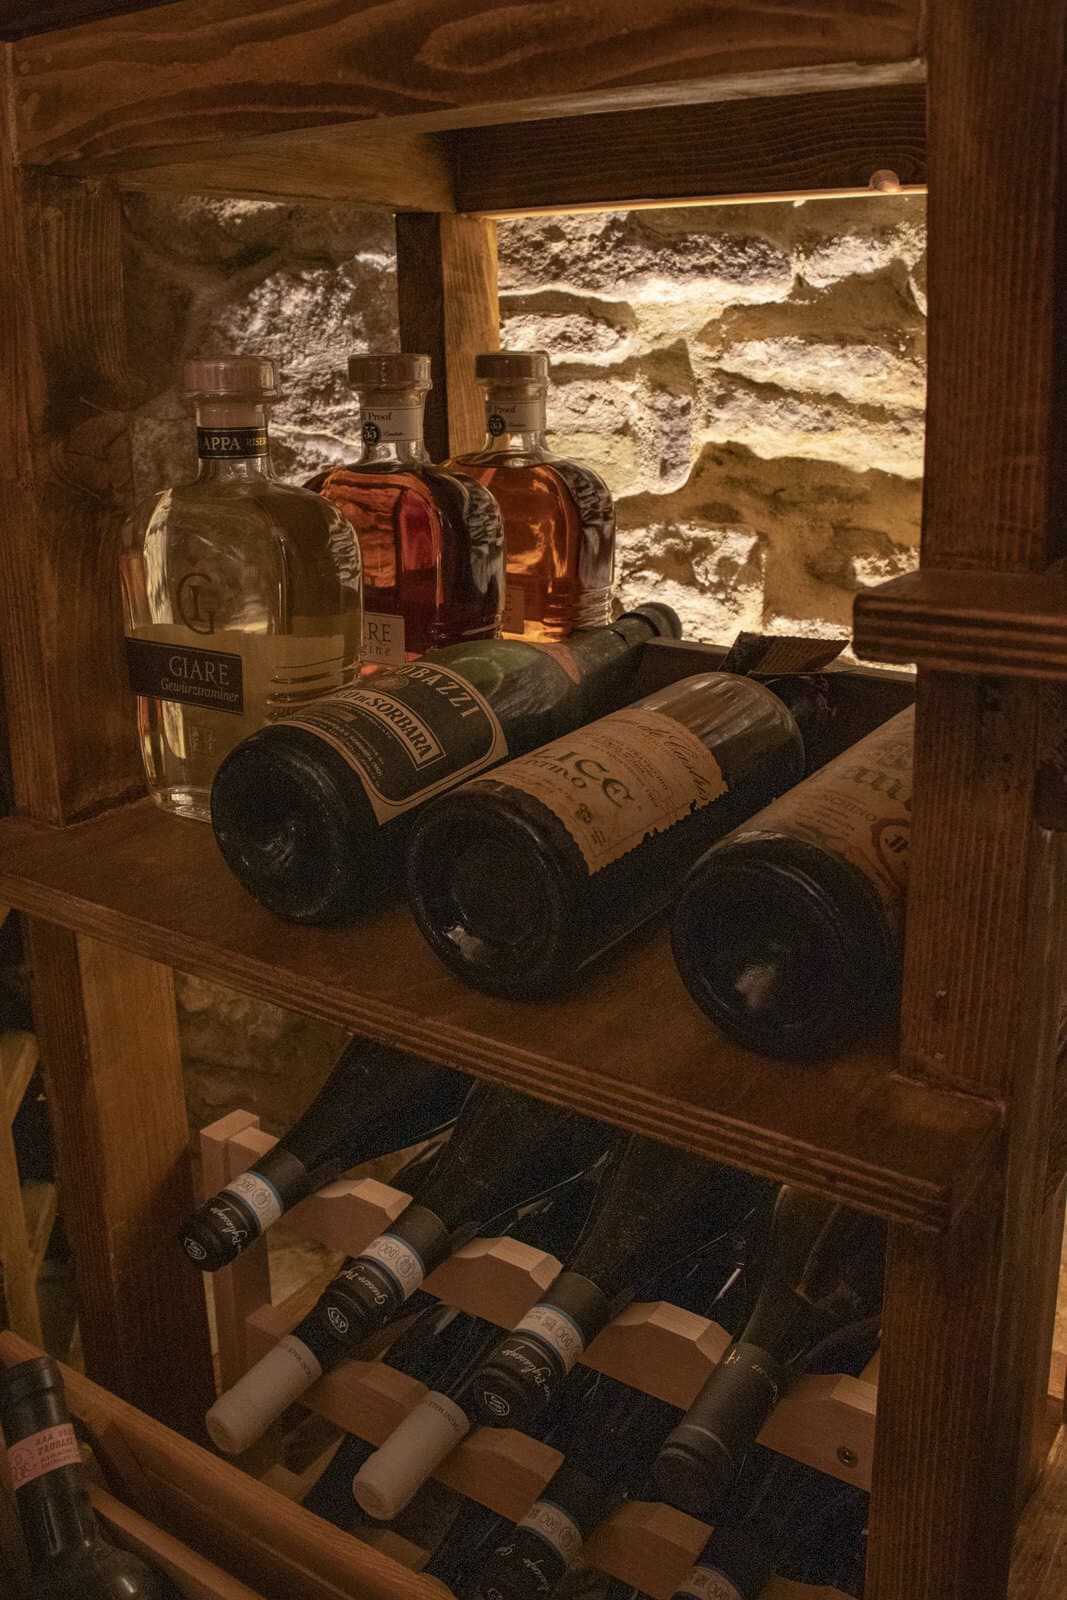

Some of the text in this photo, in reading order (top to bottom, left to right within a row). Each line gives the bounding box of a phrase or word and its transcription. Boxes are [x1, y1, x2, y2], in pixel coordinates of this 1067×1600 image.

[368, 411, 392, 421] Proof
[364, 427, 376, 441] 55
[169, 655, 230, 686] GIARE
[368, 697, 433, 759] SORBARA
